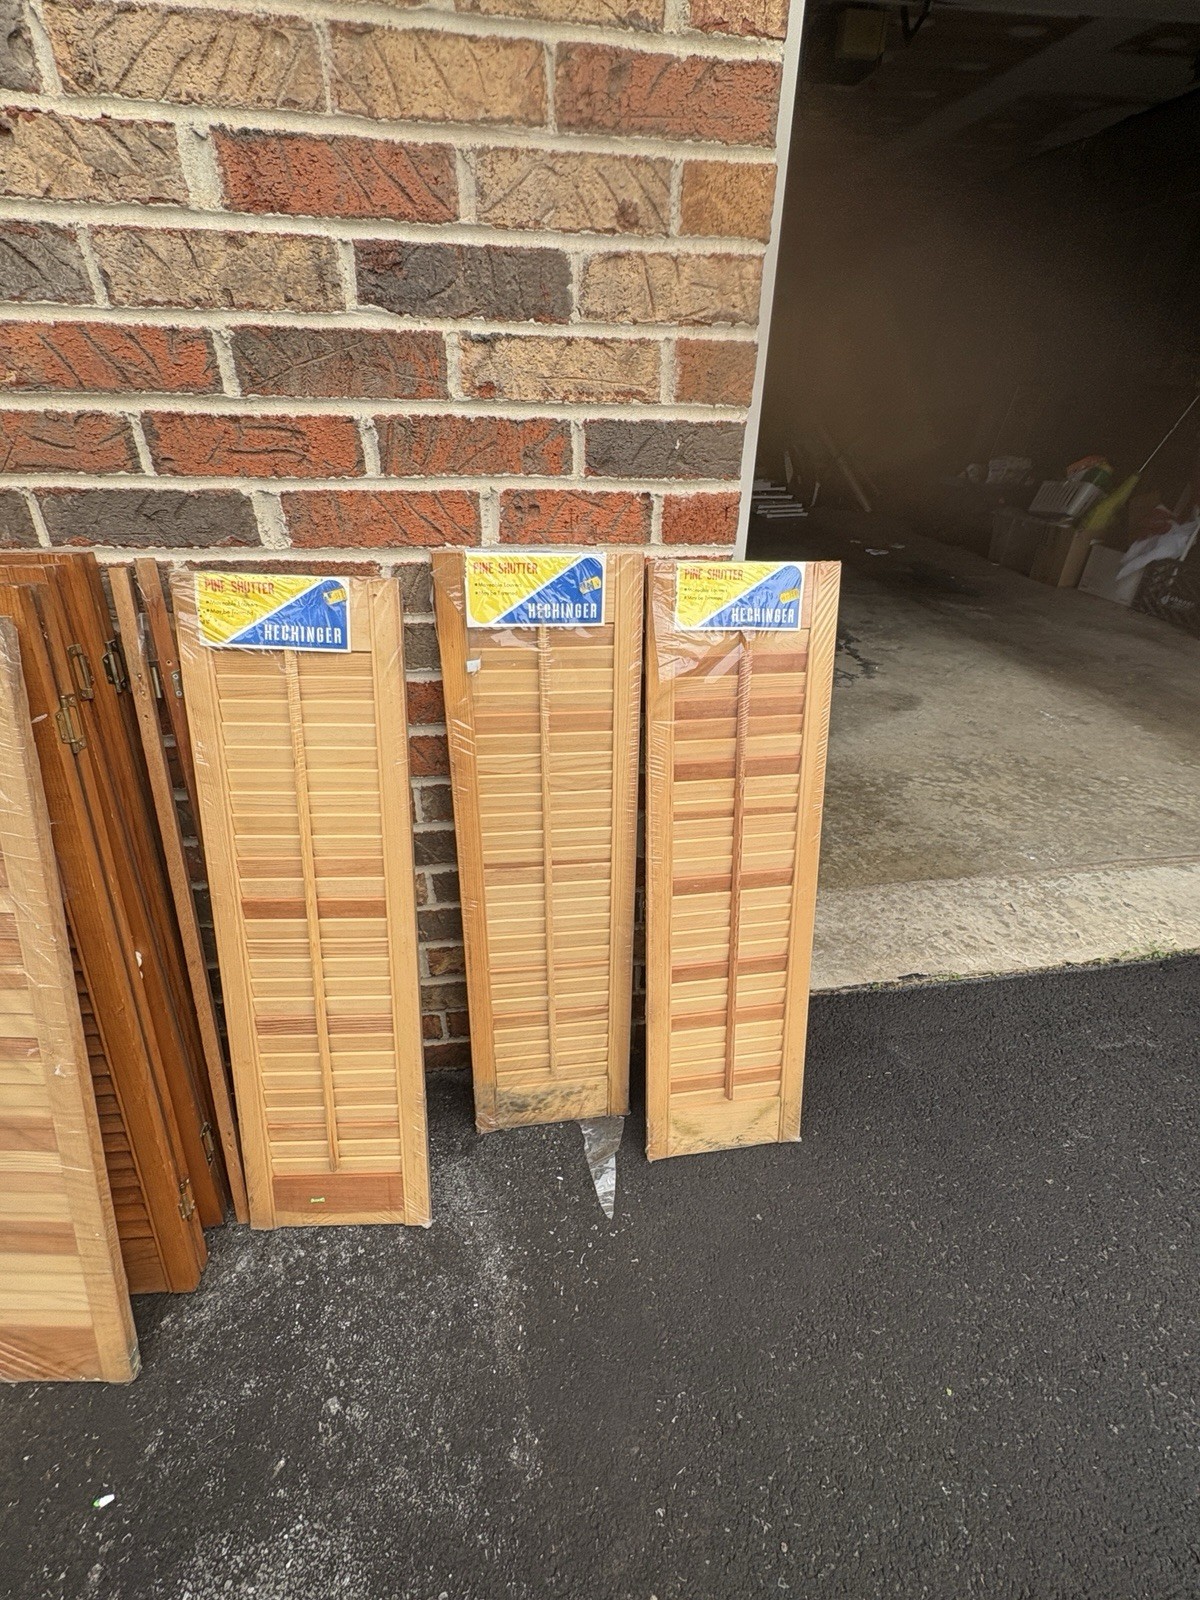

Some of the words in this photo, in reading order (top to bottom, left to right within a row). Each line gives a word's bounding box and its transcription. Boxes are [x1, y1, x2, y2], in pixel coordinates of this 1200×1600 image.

[498, 562, 538, 575] SHUTTER
[708, 568, 744, 581] SHUTTER
[231, 580, 274, 595] SHUTTER
[528, 602, 597, 619] HECHINGER
[731, 606, 794, 623] HECHINGER
[264, 623, 342, 644] HECHINGER
